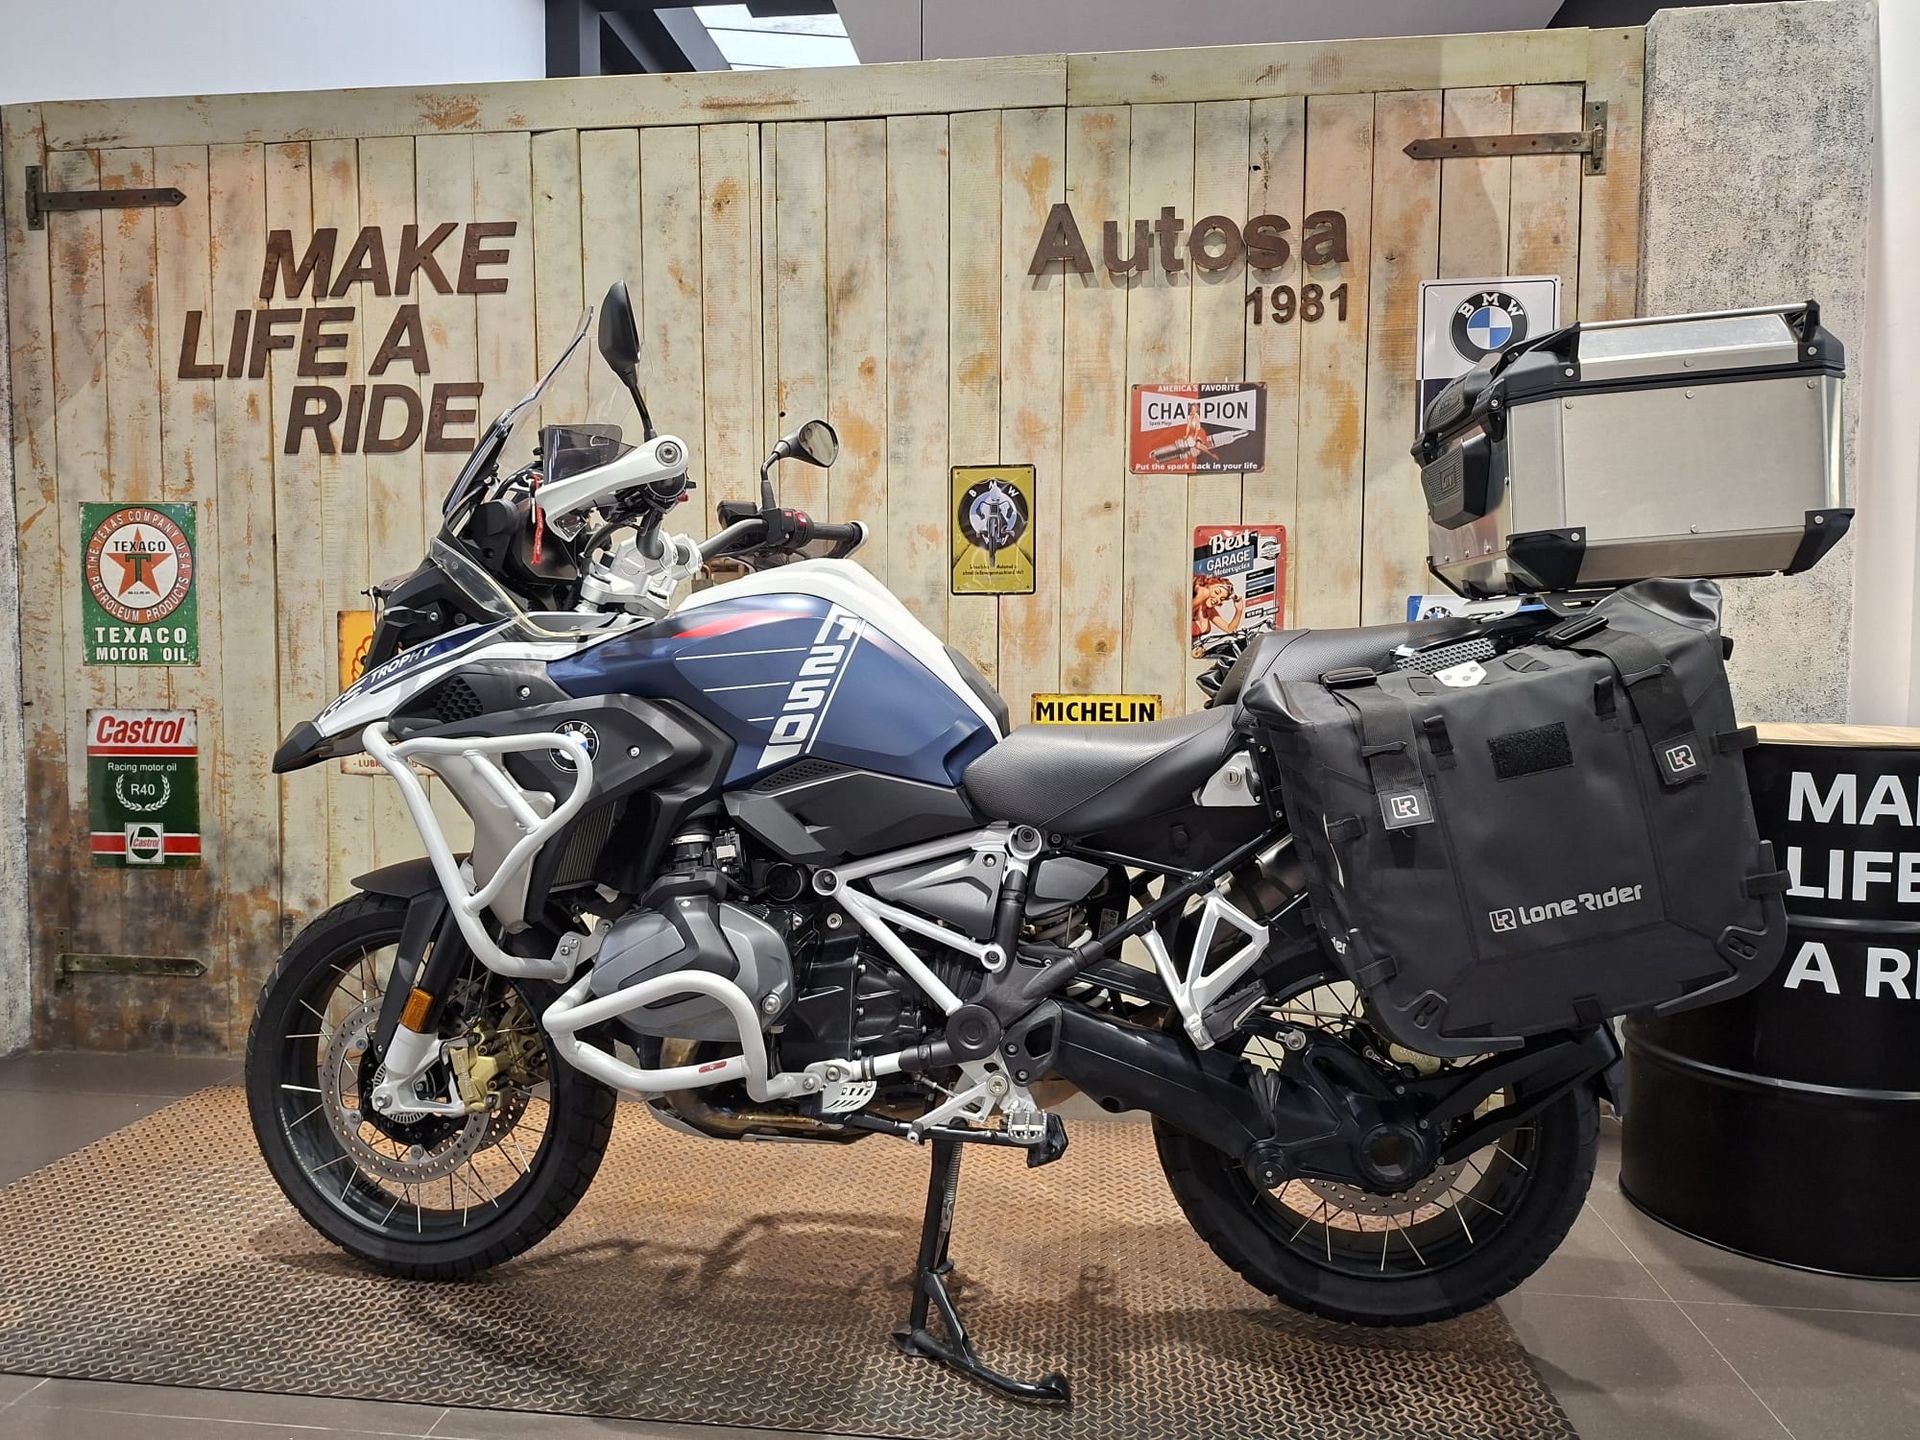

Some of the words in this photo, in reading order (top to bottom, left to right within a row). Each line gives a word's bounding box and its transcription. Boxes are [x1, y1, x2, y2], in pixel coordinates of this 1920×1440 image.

[1027, 203, 1350, 276] Autosa
[259, 221, 517, 299] MAKE
[1245, 283, 1348, 325] 1981
[1457, 293, 1524, 319] BMW
[178, 307, 356, 379] LIFE
[368, 304, 431, 376] A
[1158, 384, 1198, 392] AMERICA'S
[1201, 384, 1240, 392] FAVORITE
[284, 382, 484, 454] RIDE
[1167, 463, 1189, 472] spark
[1222, 463, 1242, 471] your
[1243, 462, 1258, 470] life
[968, 481, 1020, 498] BMW
[93, 513, 125, 544] TEXAS
[128, 510, 180, 539] COMPANY
[113, 541, 166, 552] TEXACO
[1209, 529, 1251, 555] Best
[88, 548, 100, 570] THE
[1206, 549, 1251, 571] GARAGE
[90, 576, 140, 622] PETROLEUM
[146, 576, 189, 621] PRODUCTS
[95, 627, 188, 643] TEXACO
[96, 647, 149, 661] MOTOR
[162, 647, 188, 661] OIL
[370, 643, 436, 683] TROPHY
[1036, 702, 1155, 722] MICHELIN
[96, 715, 185, 744] Castrol
[107, 762, 137, 773] Racing
[139, 763, 164, 772] motor
[166, 762, 177, 772] oil
[130, 783, 156, 796] R40
[1788, 771, 1920, 827] MA
[133, 837, 160, 848] Castrol
[1786, 846, 1920, 903] LIFE
[1518, 898, 1579, 925] Lone
[1578, 884, 1643, 911] Rider
[1783, 941, 1841, 995] A
